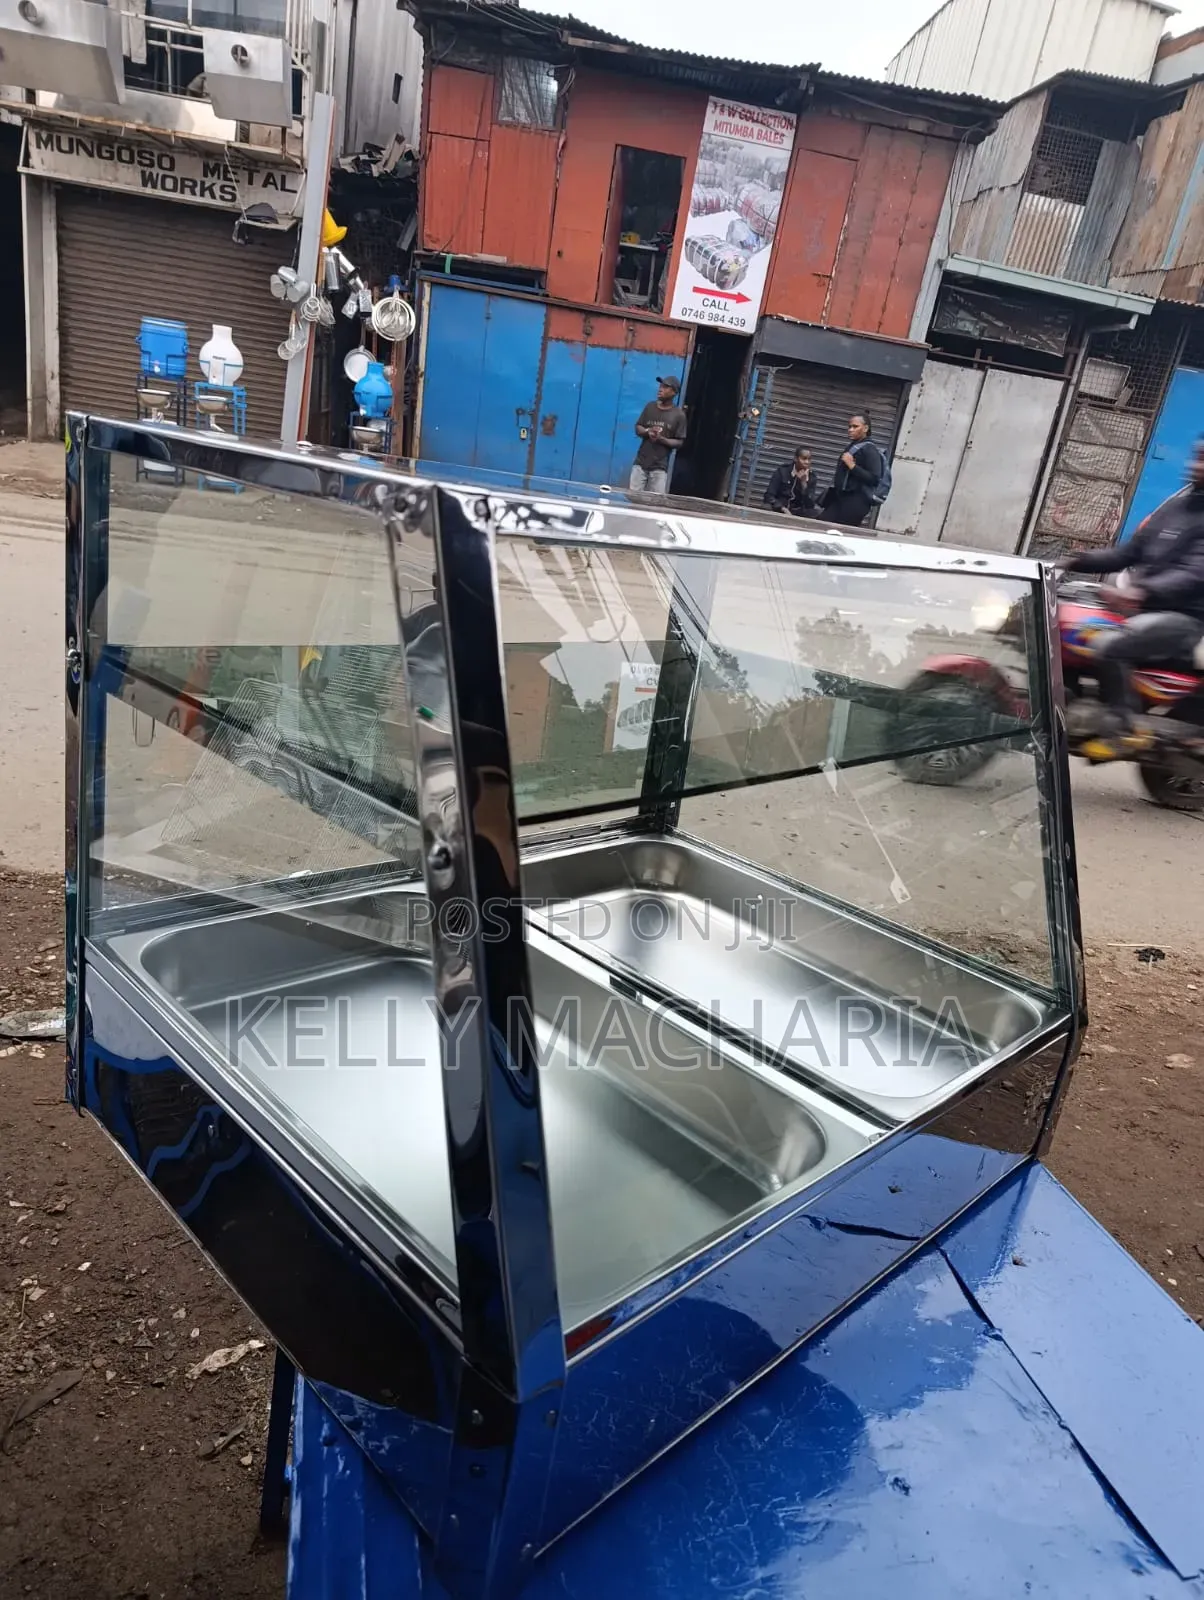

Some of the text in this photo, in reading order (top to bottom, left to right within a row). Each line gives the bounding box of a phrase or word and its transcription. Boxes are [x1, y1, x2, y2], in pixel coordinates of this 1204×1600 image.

[728, 105, 737, 118] W
[739, 108, 793, 130] COLLECTION
[713, 120, 785, 144] MITUMBA BALES
[35, 132, 298, 194] MUNGOSO METAL
[140, 170, 237, 202] WORKS
[702, 297, 730, 312] CALL
[681, 307, 746, 327] 0746 984 439
